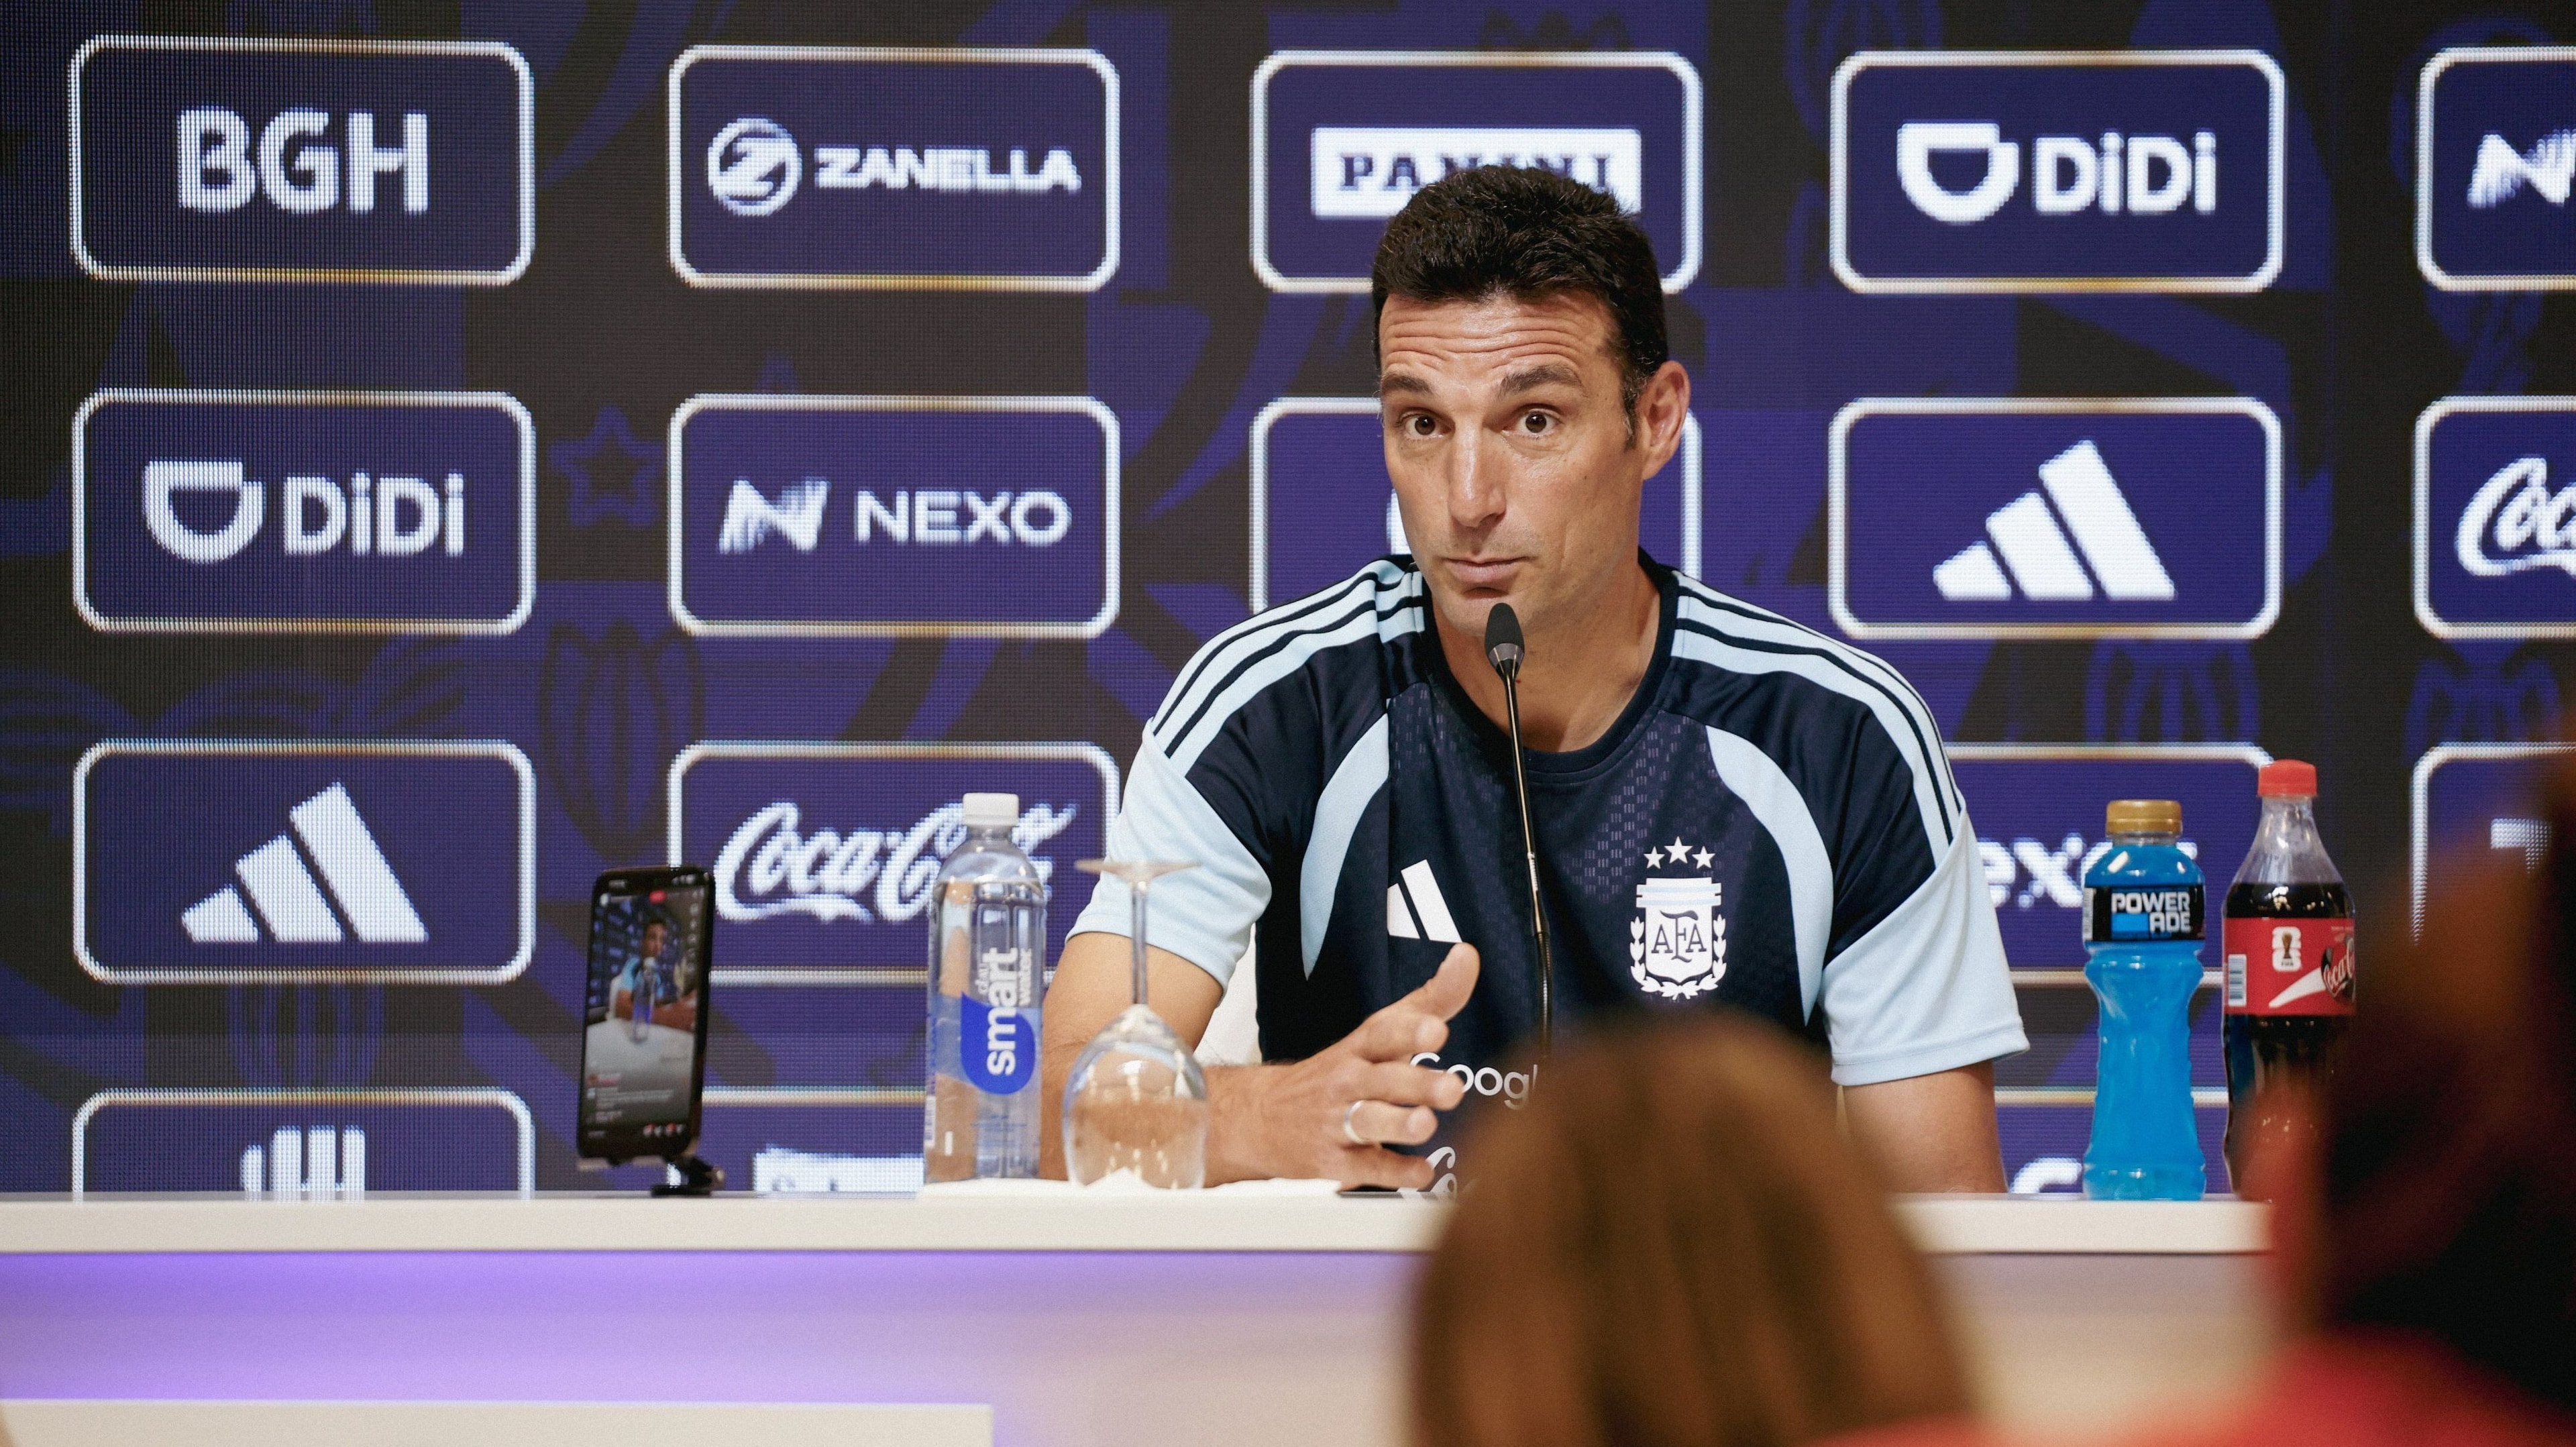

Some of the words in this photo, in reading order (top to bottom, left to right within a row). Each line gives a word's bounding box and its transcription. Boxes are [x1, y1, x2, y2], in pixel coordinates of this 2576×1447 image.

[178, 107, 429, 215] BGH
[814, 146, 1082, 193] ZANELLA
[2034, 129, 2216, 215] DiDi
[282, 470, 464, 557] DiDi
[855, 488, 1072, 547] NEXO
[2111, 892, 2190, 914] POWER
[2149, 911, 2192, 933] ADE
[987, 947, 1018, 1076] smart
